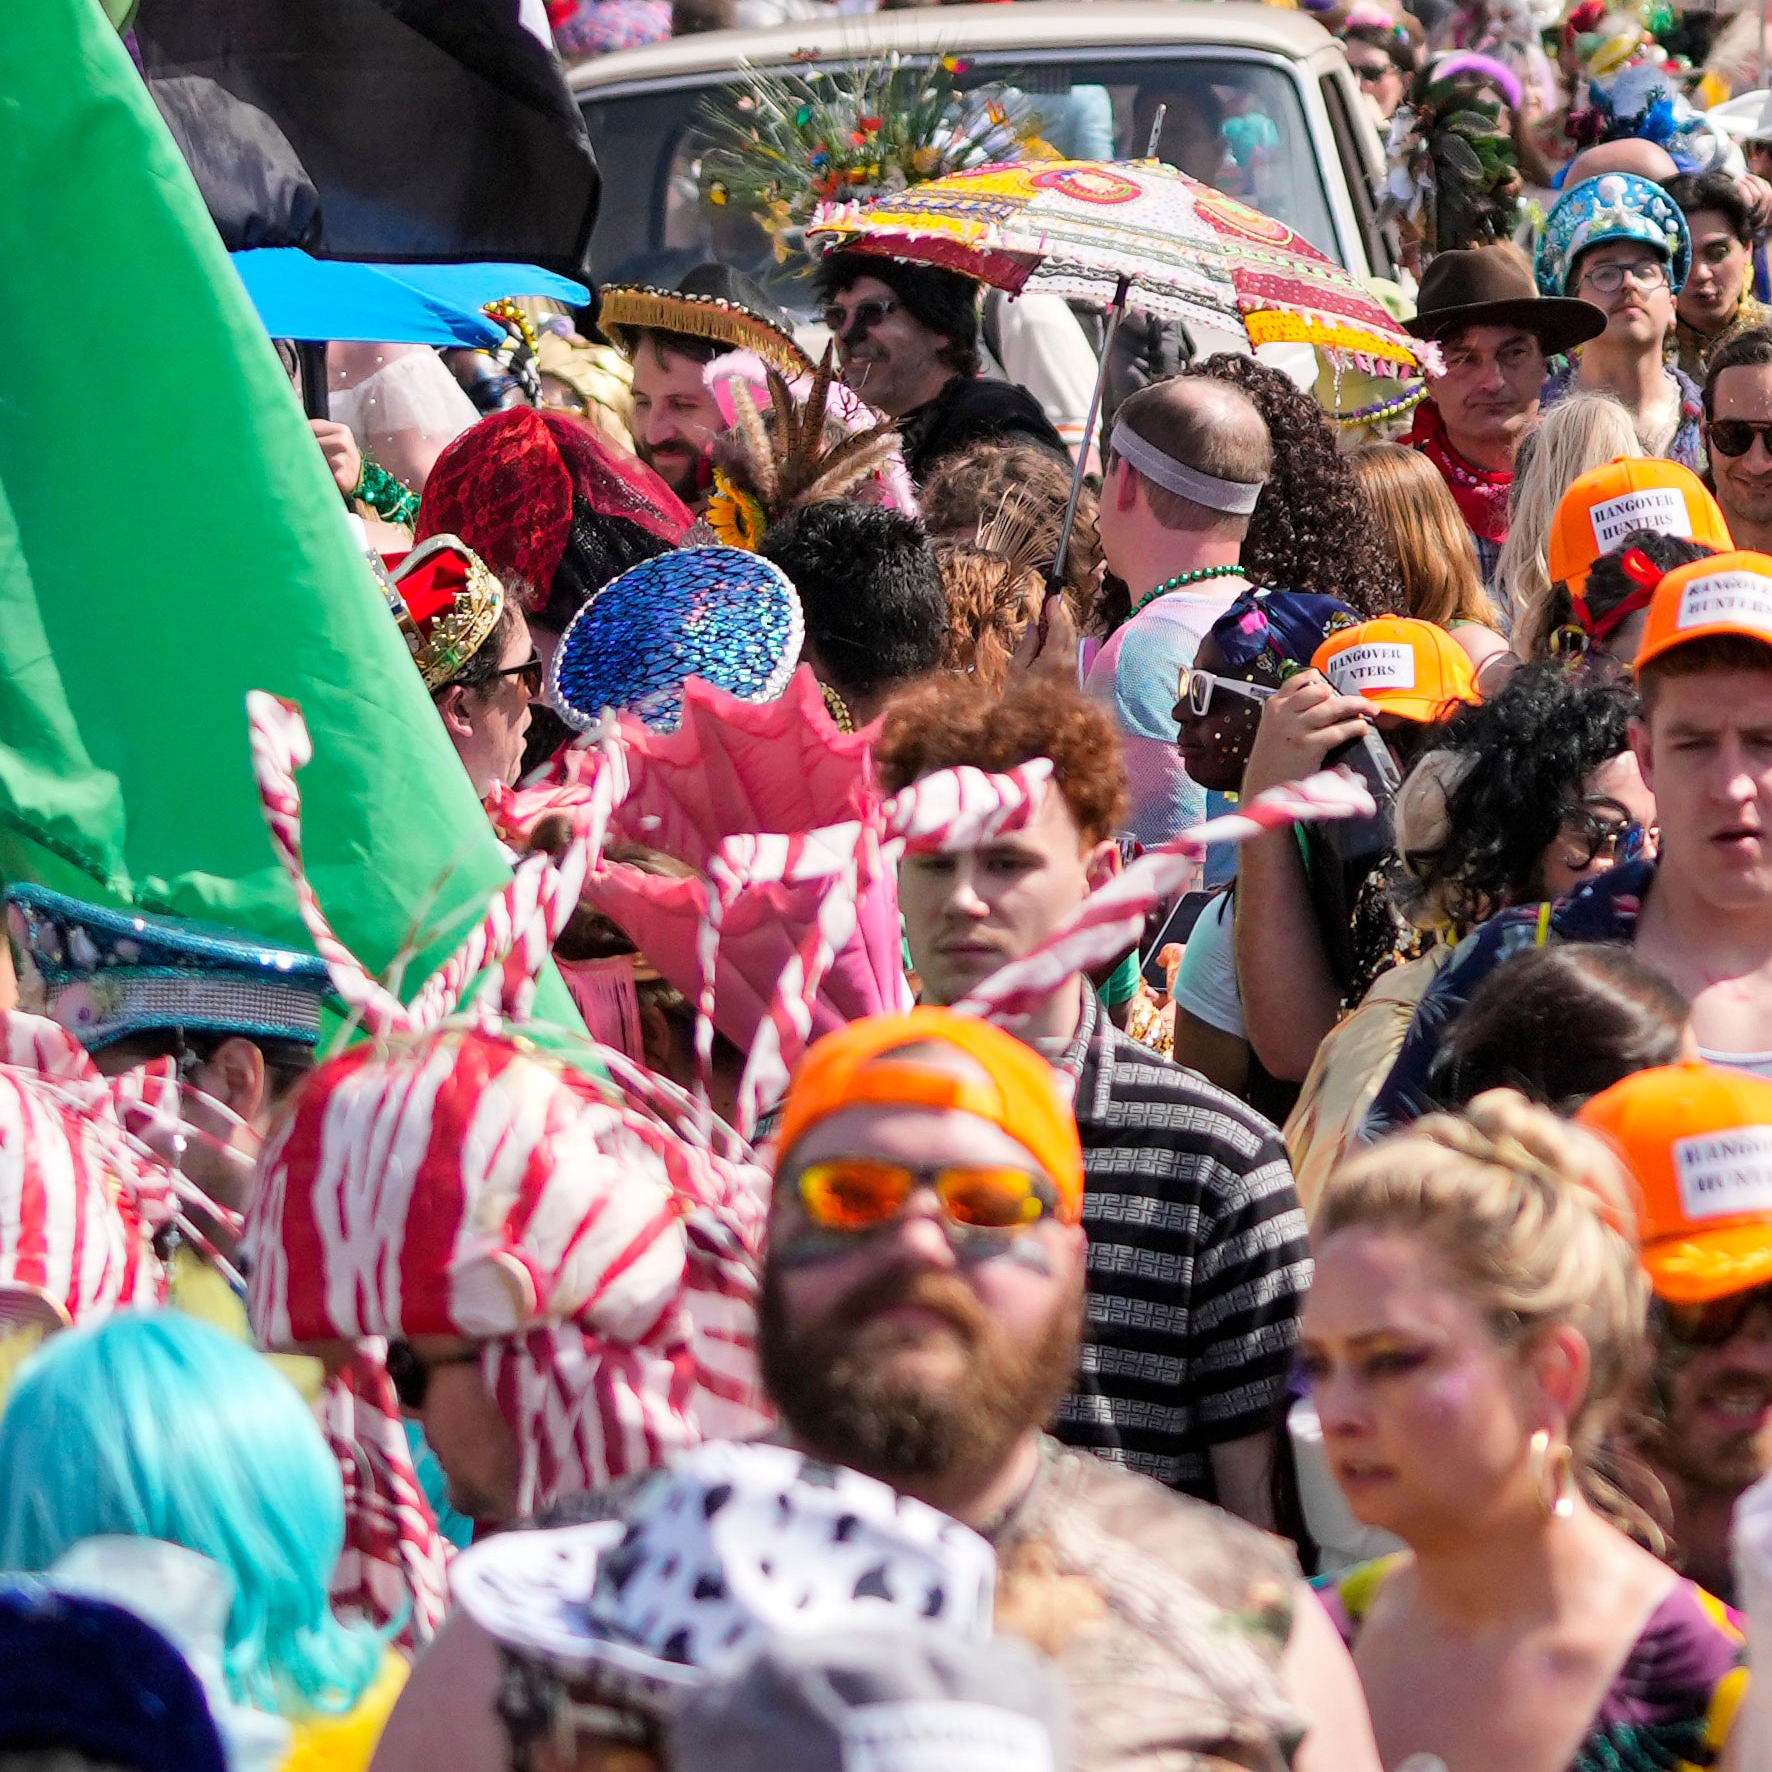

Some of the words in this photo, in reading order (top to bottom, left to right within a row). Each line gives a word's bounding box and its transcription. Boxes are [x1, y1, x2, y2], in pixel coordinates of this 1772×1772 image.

[1594, 494, 1675, 524] HANGOVER
[1602, 512, 1674, 541] HUNTERS
[1329, 648, 1403, 674] HANGOVER
[1349, 665, 1396, 680] NTERS
